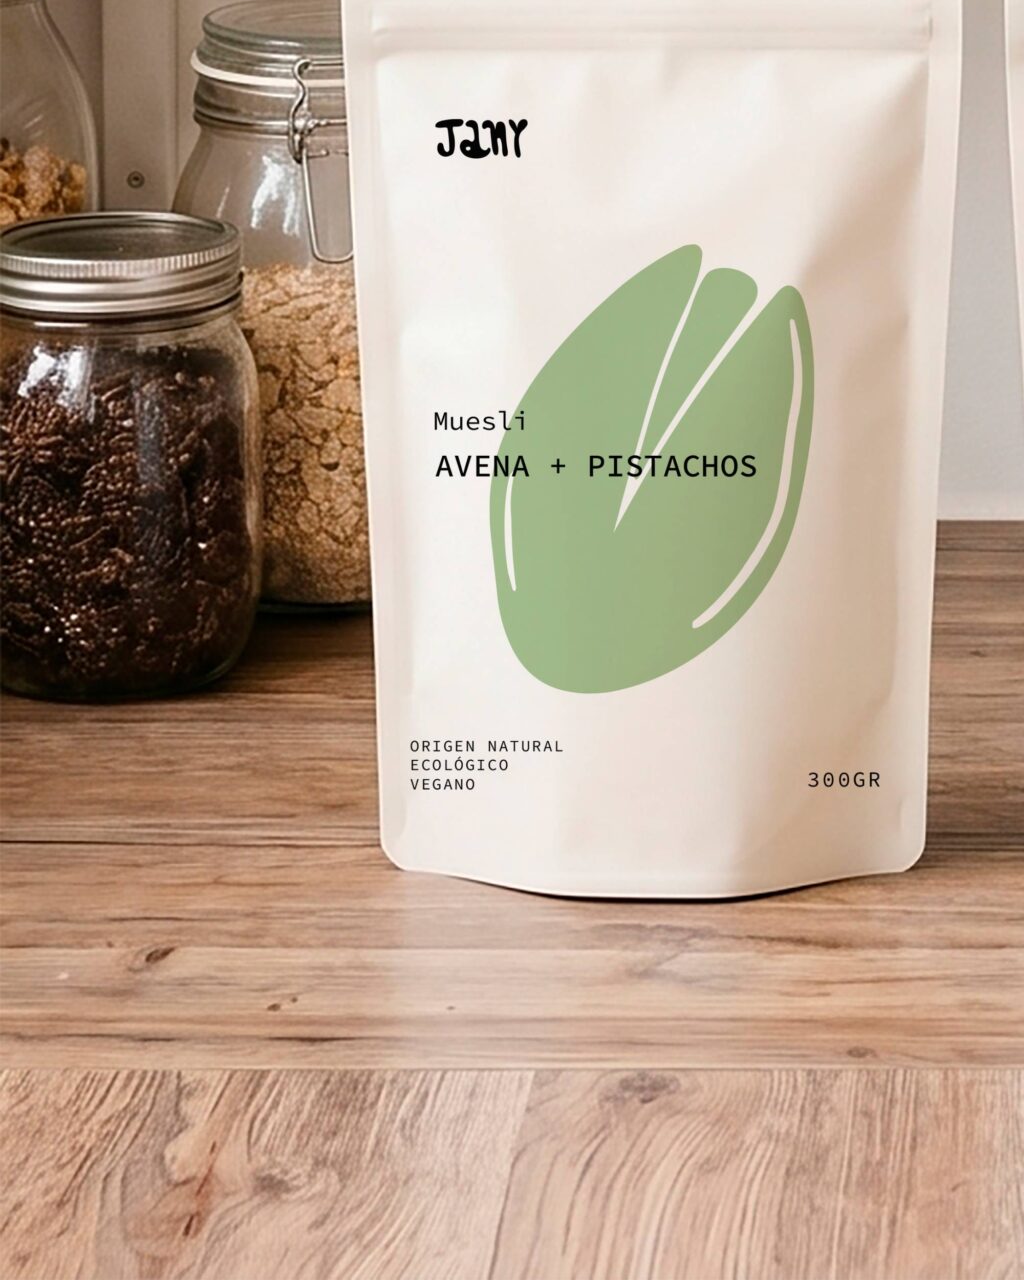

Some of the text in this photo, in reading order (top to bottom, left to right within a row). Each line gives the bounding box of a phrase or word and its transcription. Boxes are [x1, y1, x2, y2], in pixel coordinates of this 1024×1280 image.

[433, 410, 526, 431] Muesli
[435, 454, 758, 478] AVENA + PISTACHOS
[410, 740, 564, 753] ORIGEN NATURAL
[410, 756, 509, 771] ECOLÓGICO
[410, 778, 476, 791] VEGANO
[808, 771, 881, 788] 300GR
